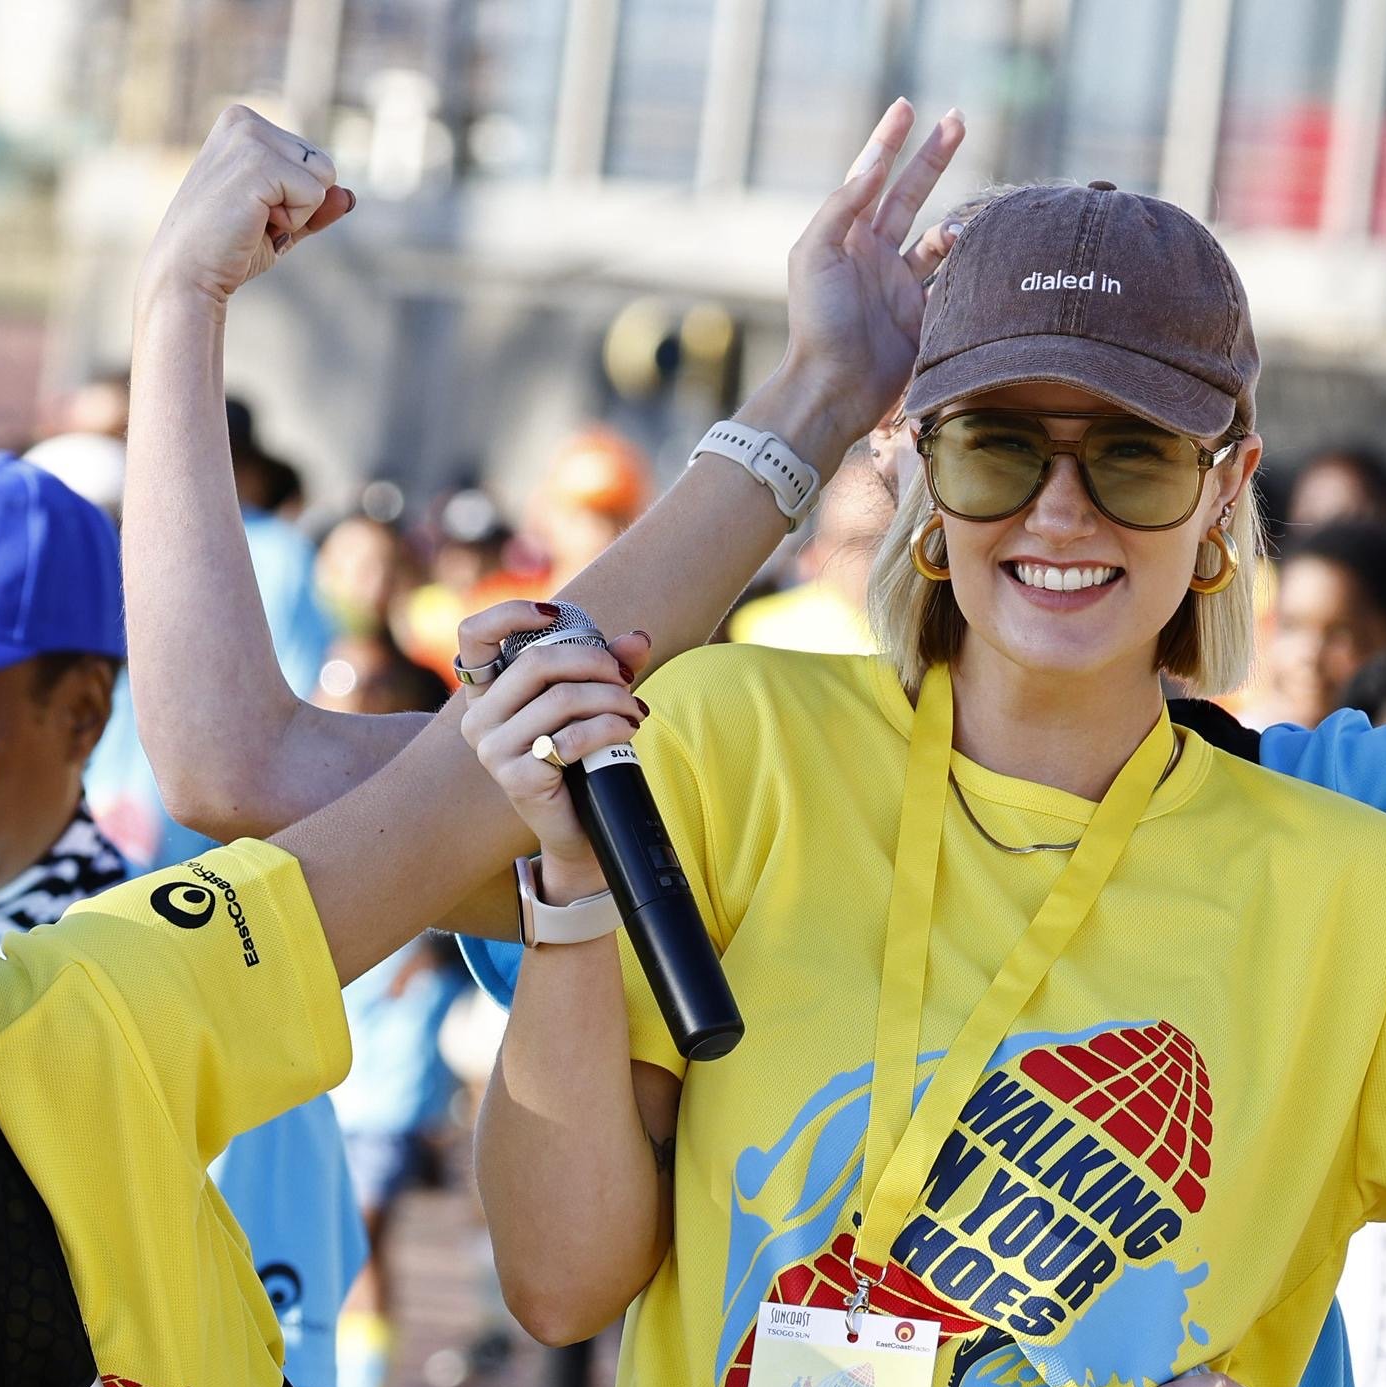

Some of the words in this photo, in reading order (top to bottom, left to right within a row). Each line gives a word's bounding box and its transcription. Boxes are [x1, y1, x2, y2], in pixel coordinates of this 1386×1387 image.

[1020, 270, 1095, 292] dialed
[1101, 273, 1122, 295] in
[611, 749, 630, 758] SLX
[957, 1069, 1183, 1260] WALKING
[921, 1128, 987, 1213] N
[959, 1167, 1118, 1311] YOUR
[890, 1213, 1068, 1337] HOES
[770, 1307, 812, 1327] SUNCOAST
[767, 1328, 794, 1338] TSOGO
[795, 1330, 811, 1339] SUN
